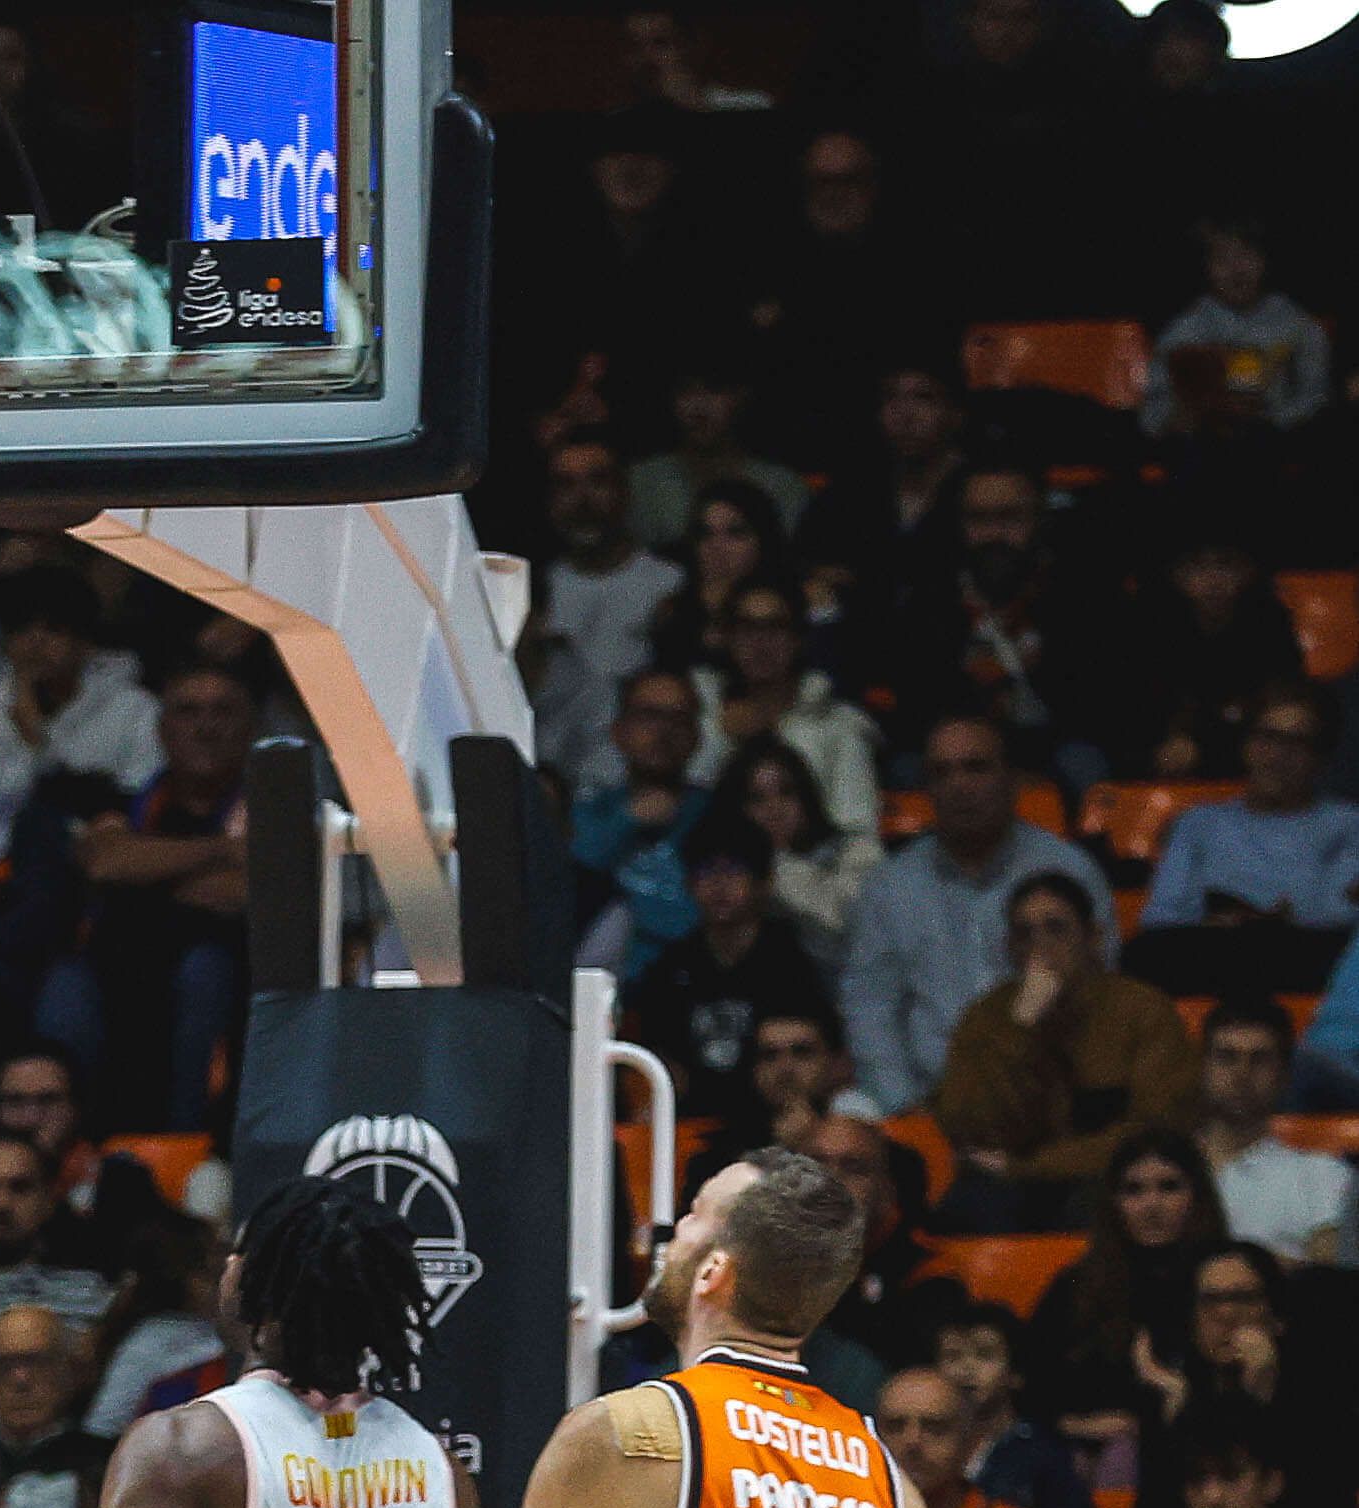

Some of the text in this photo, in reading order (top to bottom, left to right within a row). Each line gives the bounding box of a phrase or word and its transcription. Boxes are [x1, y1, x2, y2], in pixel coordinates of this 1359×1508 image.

[238, 289, 280, 314] liga
[238, 308, 323, 328] endesa
[724, 1398, 869, 1478] COSTELLO
